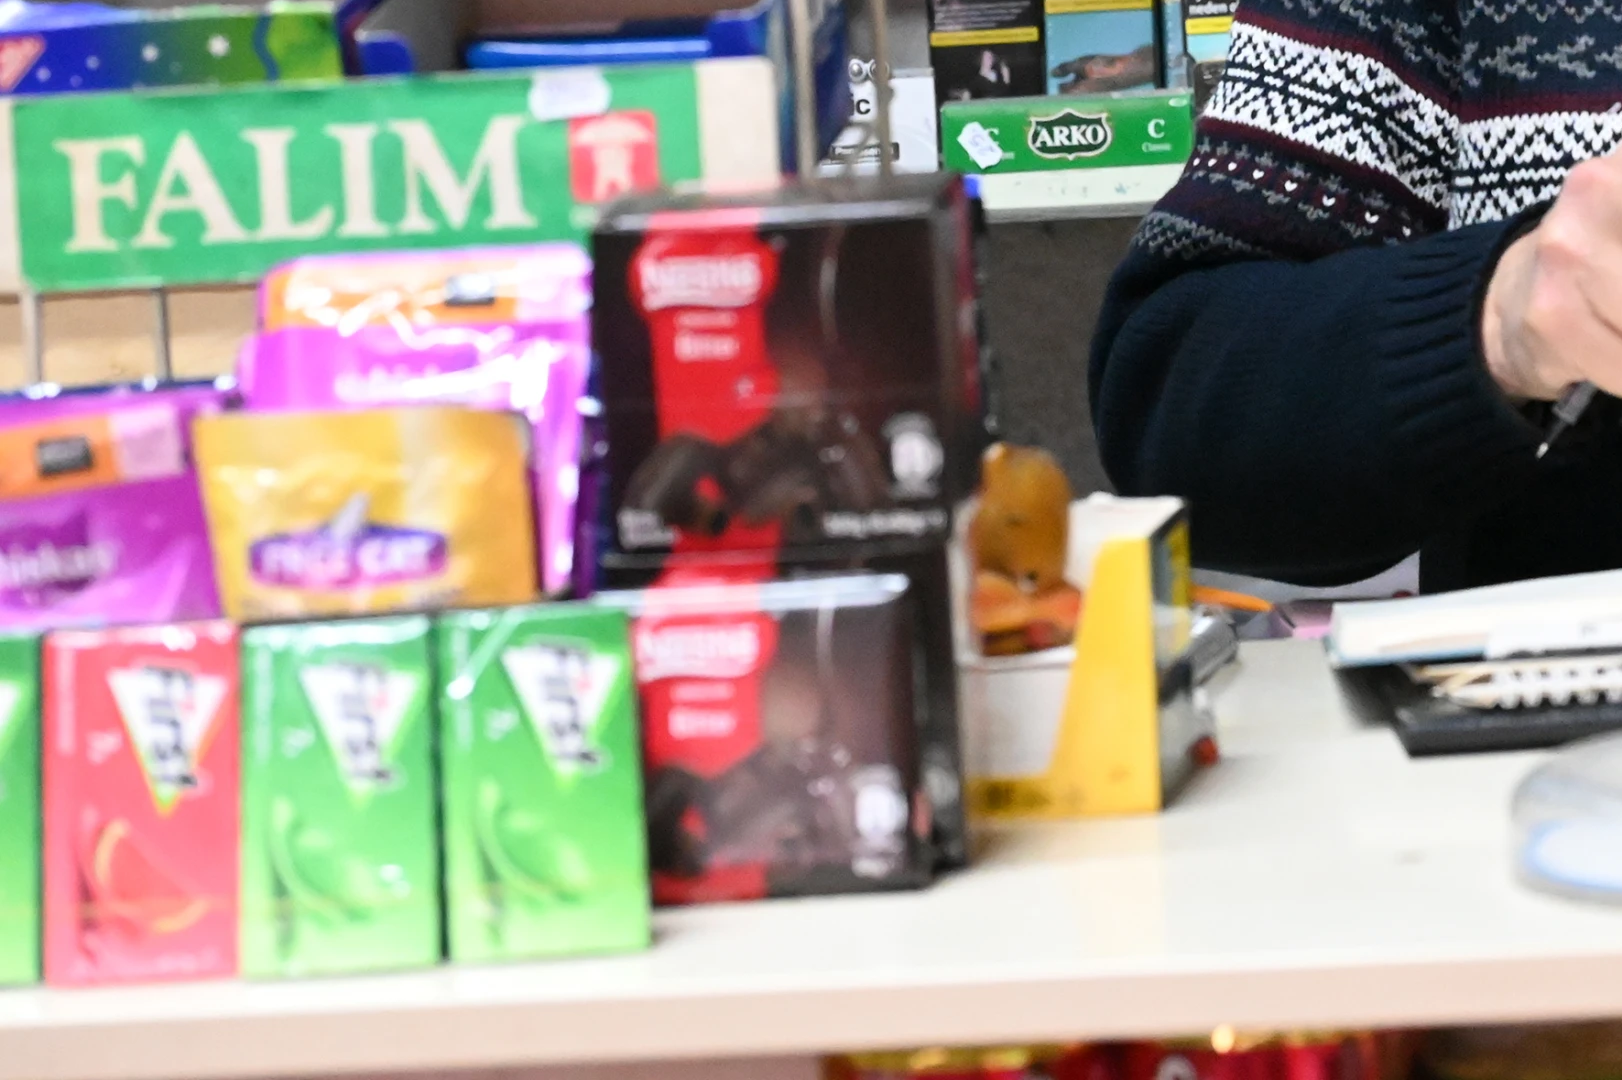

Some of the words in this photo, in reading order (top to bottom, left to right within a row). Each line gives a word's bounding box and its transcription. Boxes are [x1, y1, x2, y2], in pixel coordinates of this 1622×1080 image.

[1034, 123, 1106, 148] ARKO
[1147, 118, 1166, 138] C
[54, 113, 537, 253] FALIM
